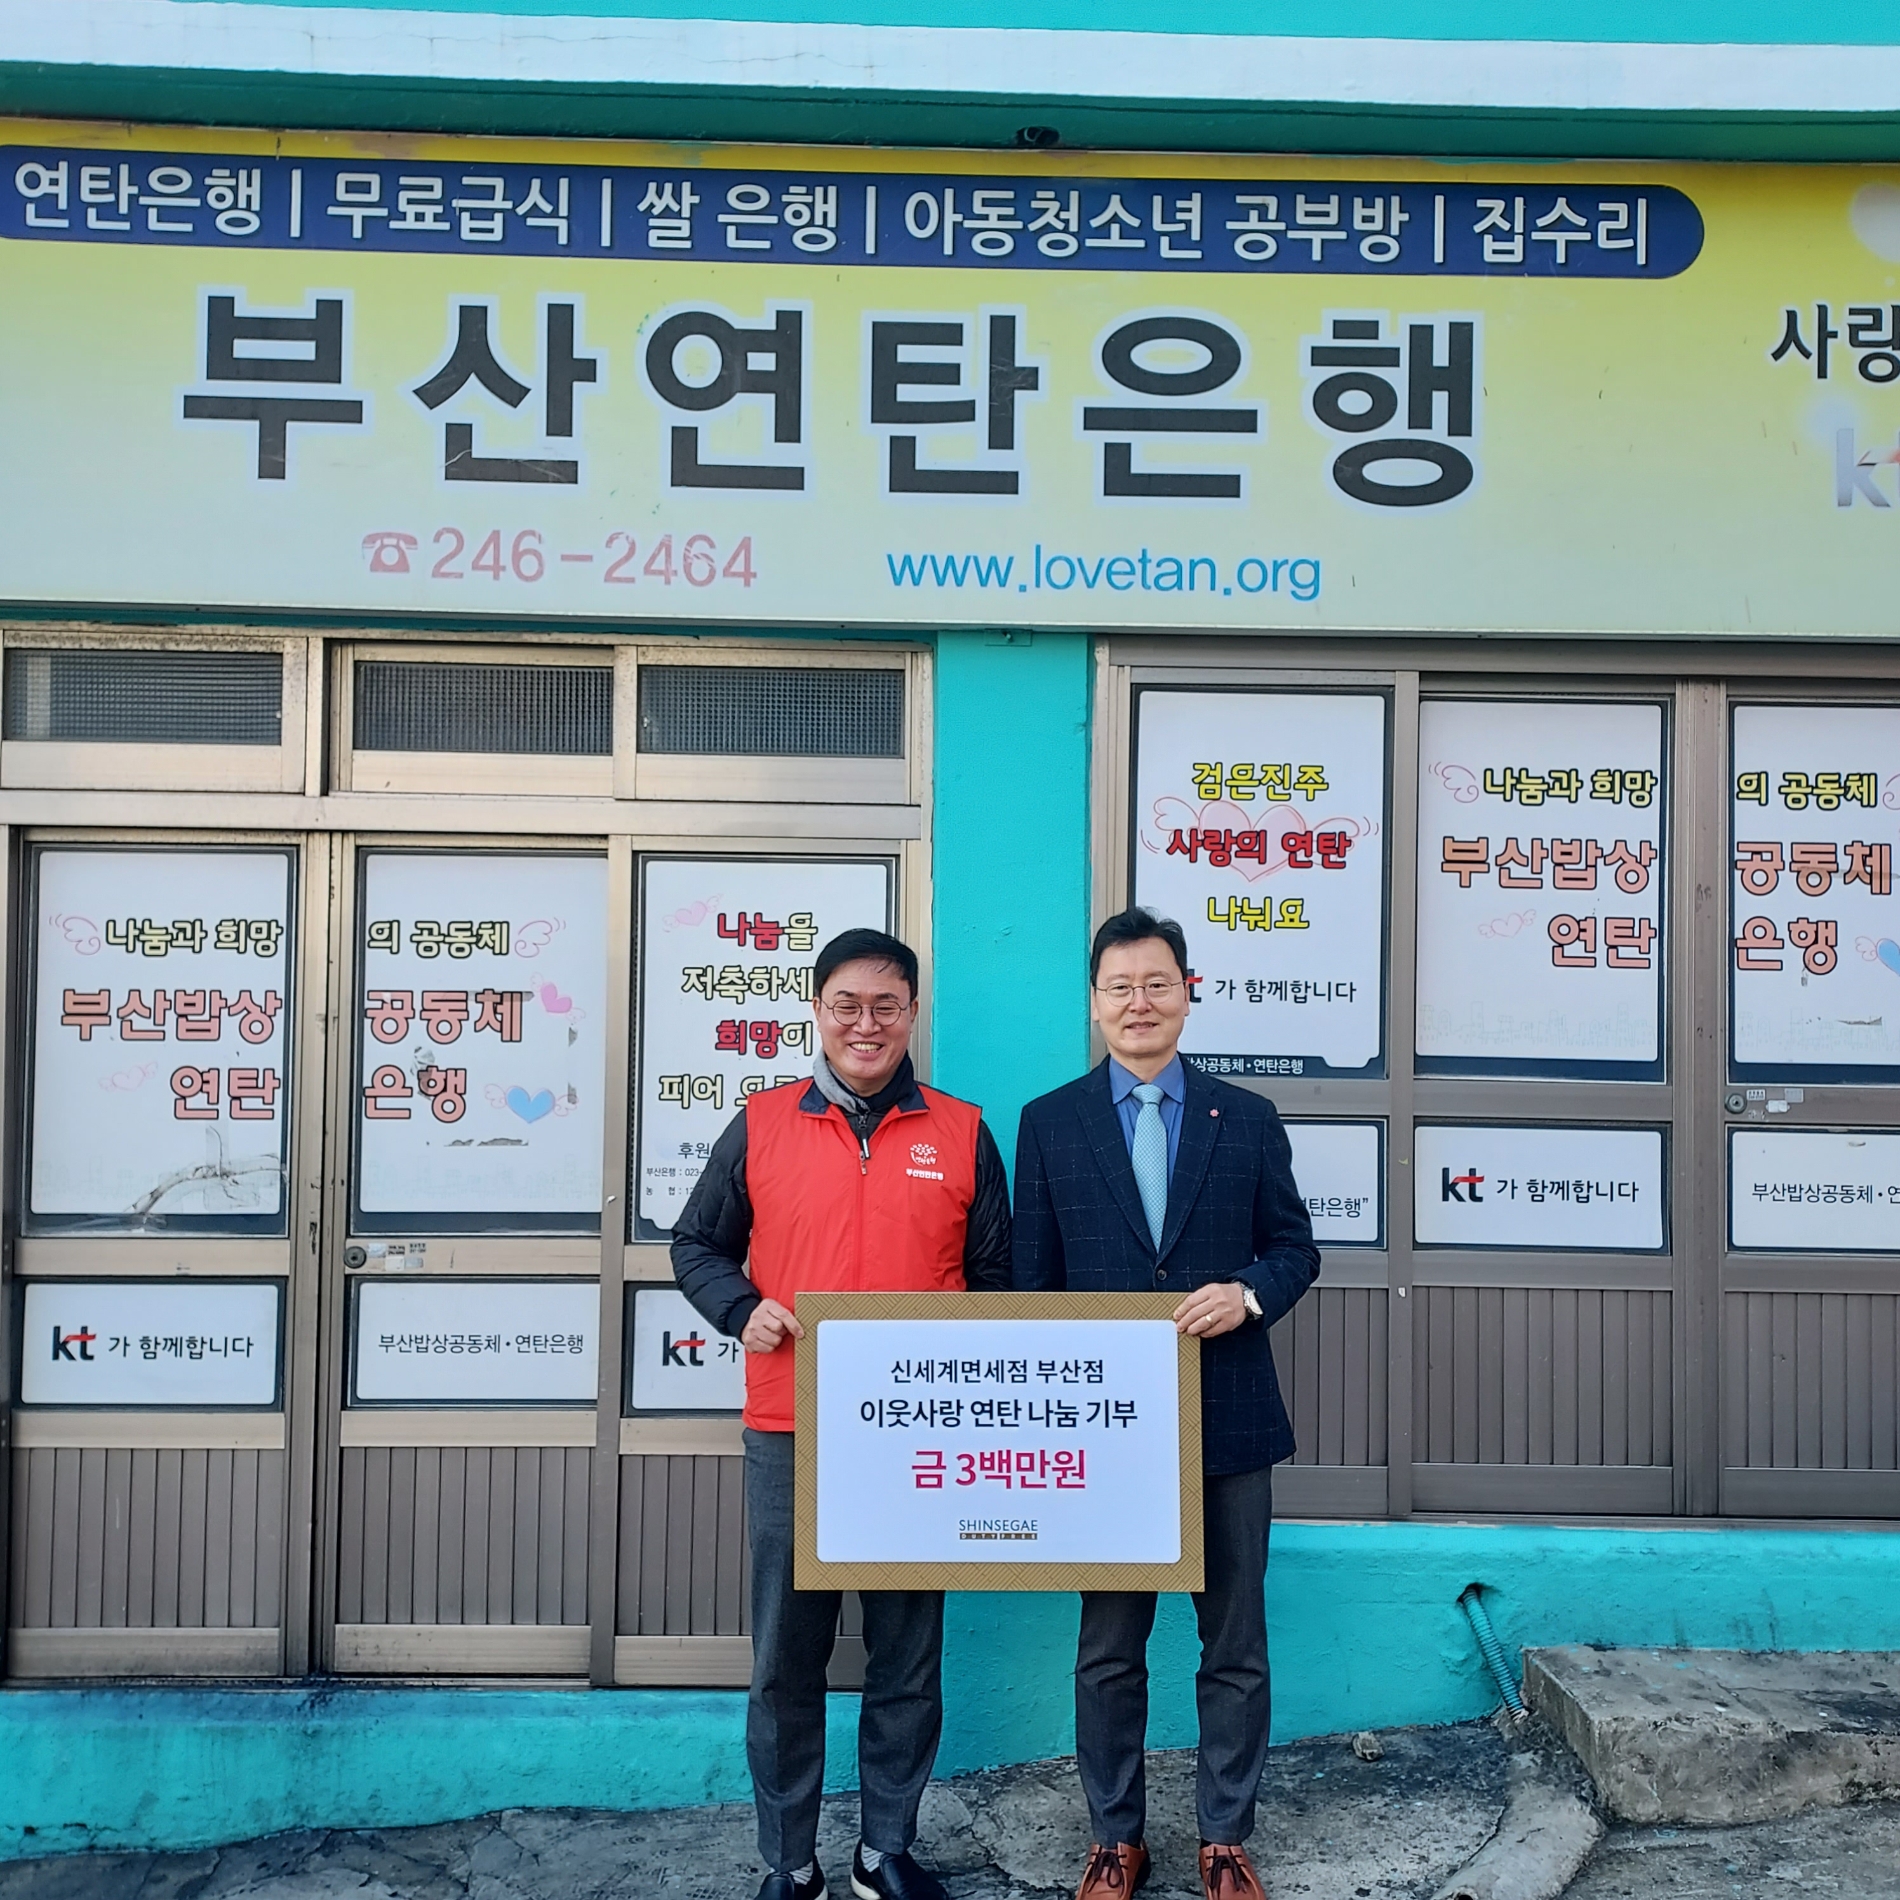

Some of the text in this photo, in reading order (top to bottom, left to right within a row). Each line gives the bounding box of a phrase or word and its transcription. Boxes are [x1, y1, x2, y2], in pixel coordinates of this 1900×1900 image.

[14, 160, 1649, 266] 연탄은행 무료급식 쌀 은행 아동청소년 공부방 집수리
[1771, 303, 1900, 383] 사랑
[183, 295, 1475, 506] 부산연탄은행
[1836, 428, 1900, 508] k
[432, 528, 759, 588] 246-2464
[886, 544, 1322, 601] www.lovetan.org
[1191, 761, 1330, 803] 검은진주
[1482, 767, 1658, 808] 나눔과 희망
[1736, 771, 1878, 811] 의 공동체
[1166, 827, 1352, 870] 사랑의 연탄
[1440, 836, 1659, 895] 부산밥상
[1735, 840, 1893, 897] 공동체
[717, 911, 819, 951] 나눔을
[1206, 896, 1310, 933] 나눠요
[105, 918, 283, 957] 나눔과 희망
[367, 920, 511, 959] 의 공동체
[1547, 913, 1658, 970] 연탄
[1735, 915, 1838, 976] 은행
[681, 964, 814, 1005] 저축하세
[1187, 968, 1357, 1004] t 가 함께합니다
[61, 988, 283, 1044] 부산밥상
[364, 988, 524, 1044] 공동체
[715, 1019, 813, 1059] 희망이
[1187, 1056, 1304, 1075] 상공동체·연탄은행
[170, 1064, 281, 1120] 연탄
[362, 1064, 467, 1123] 은행
[658, 1073, 724, 1110] 피어
[646, 1167, 676, 1177] 부산은행
[1441, 1167, 1639, 1204] kt 가 함께합니다
[1301, 1197, 1369, 1218] 탄은행”
[51, 1326, 254, 1362] kt 가 함께합니다
[662, 1330, 739, 1367] kt 가
[890, 1358, 1105, 1384] 신세계면세점 부산점
[860, 1399, 1139, 1429] 이웃사랑 연탄 나눔 기부
[911, 1448, 1087, 1490] 금 3백만원
[958, 1519, 1039, 1531] SHINSEGAE
